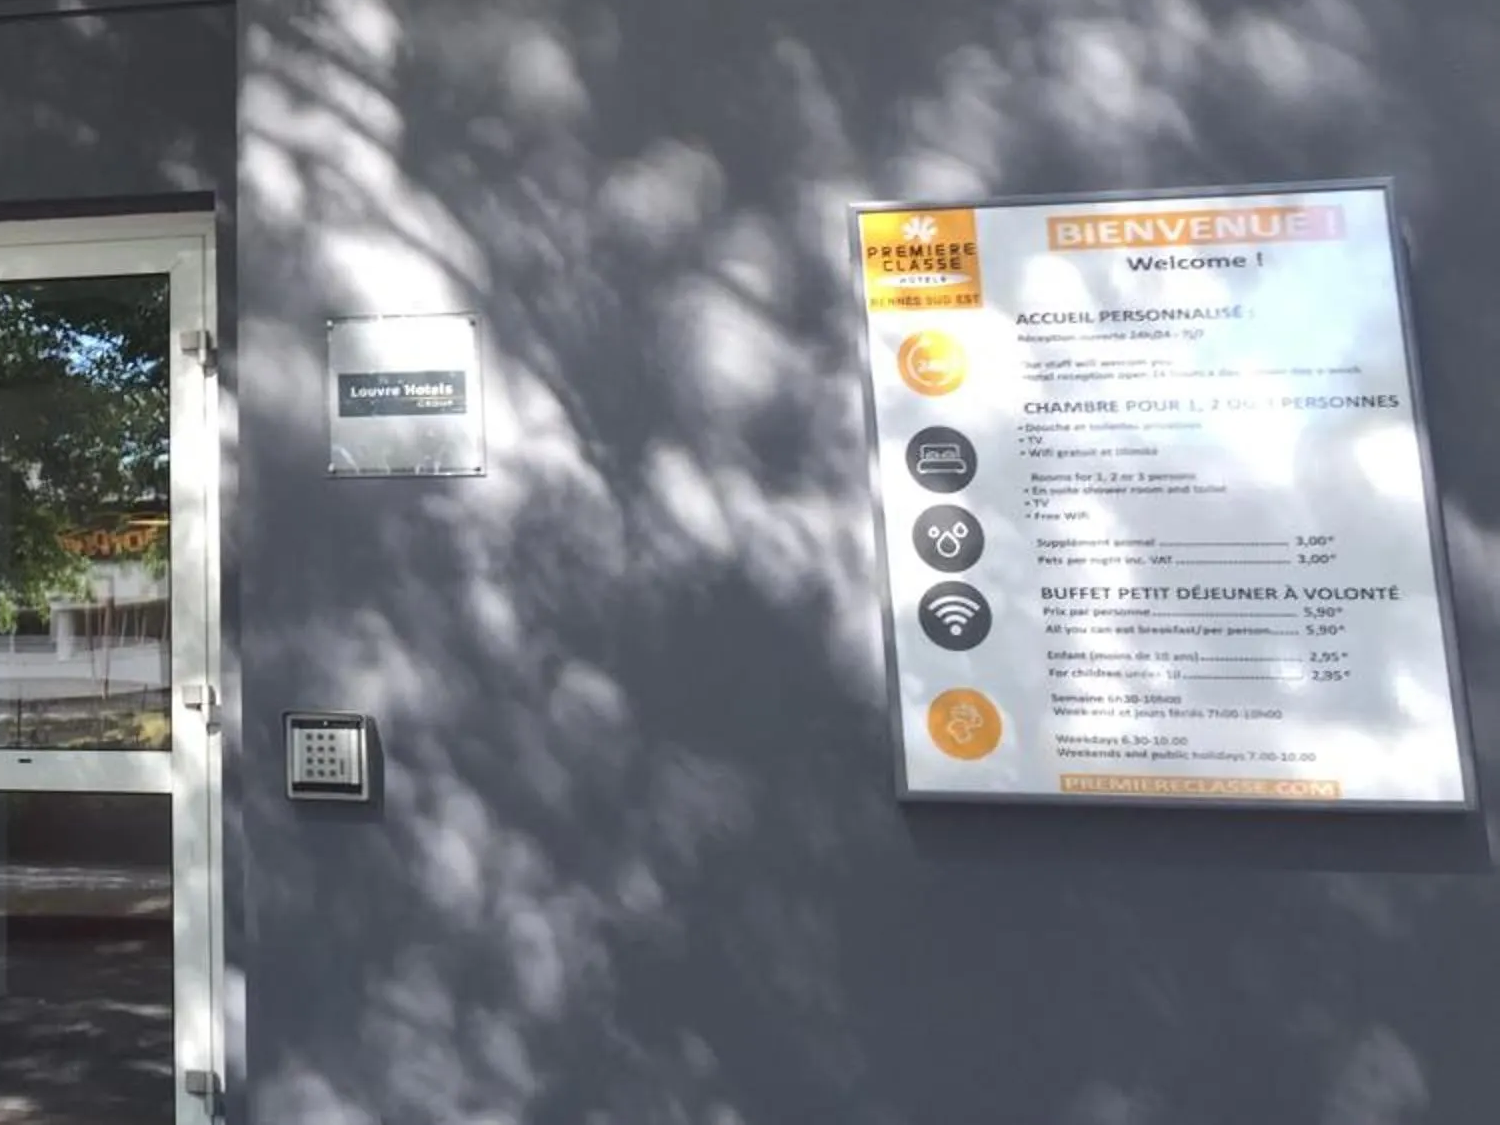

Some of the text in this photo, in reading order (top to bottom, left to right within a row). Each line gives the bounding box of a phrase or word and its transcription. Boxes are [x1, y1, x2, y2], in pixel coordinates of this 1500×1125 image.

[1056, 212, 1338, 246] BIENVENUE !
[867, 243, 977, 258] PREMIERE
[883, 257, 962, 272] CLASSE
[1127, 251, 1264, 271] Welcome !
[956, 293, 980, 305] EST
[1016, 311, 1095, 325] ACCUEIL
[350, 382, 454, 398] Louvre Hotels
[1024, 400, 1119, 415] CHAMBRE
[1126, 399, 1181, 413] POUR
[1281, 394, 1400, 410] PERSONNES
[1028, 436, 1043, 445] TV
[1033, 499, 1049, 509] TV
[1150, 555, 1173, 565] VAT
[1041, 584, 1400, 601] BUFFET PETIT DÉJEUNER À VOLONTÉ
